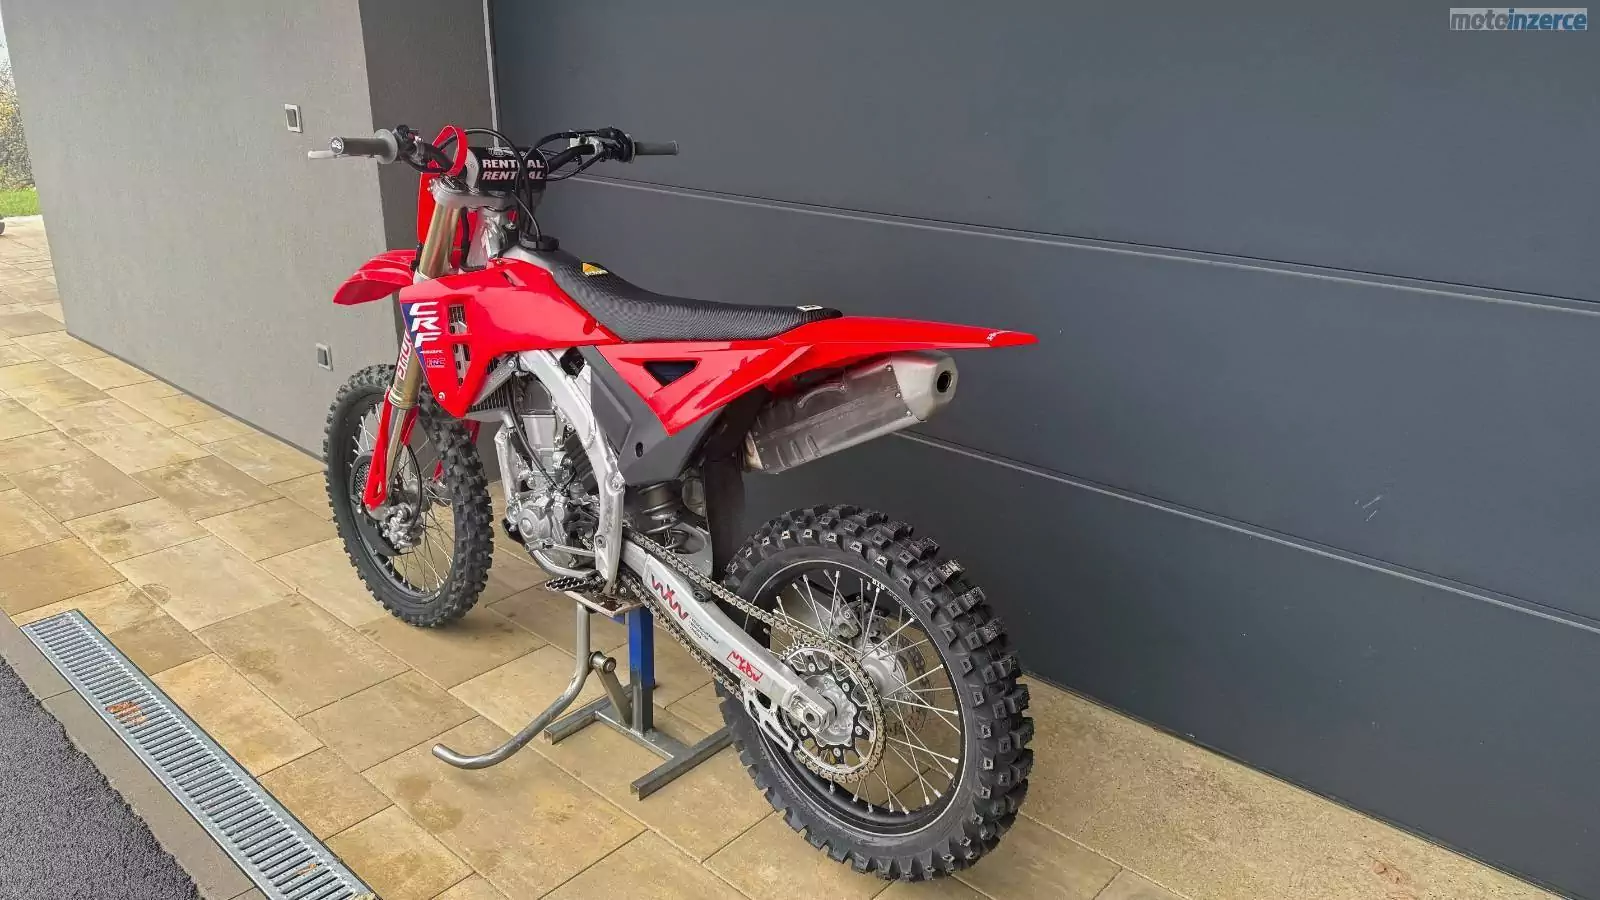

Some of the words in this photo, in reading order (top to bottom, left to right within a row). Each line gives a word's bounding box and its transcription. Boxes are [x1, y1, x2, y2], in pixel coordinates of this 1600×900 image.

[481, 159, 545, 169] RENTAL
[481, 171, 544, 181] RENTAL
[409, 301, 442, 348] CRF
